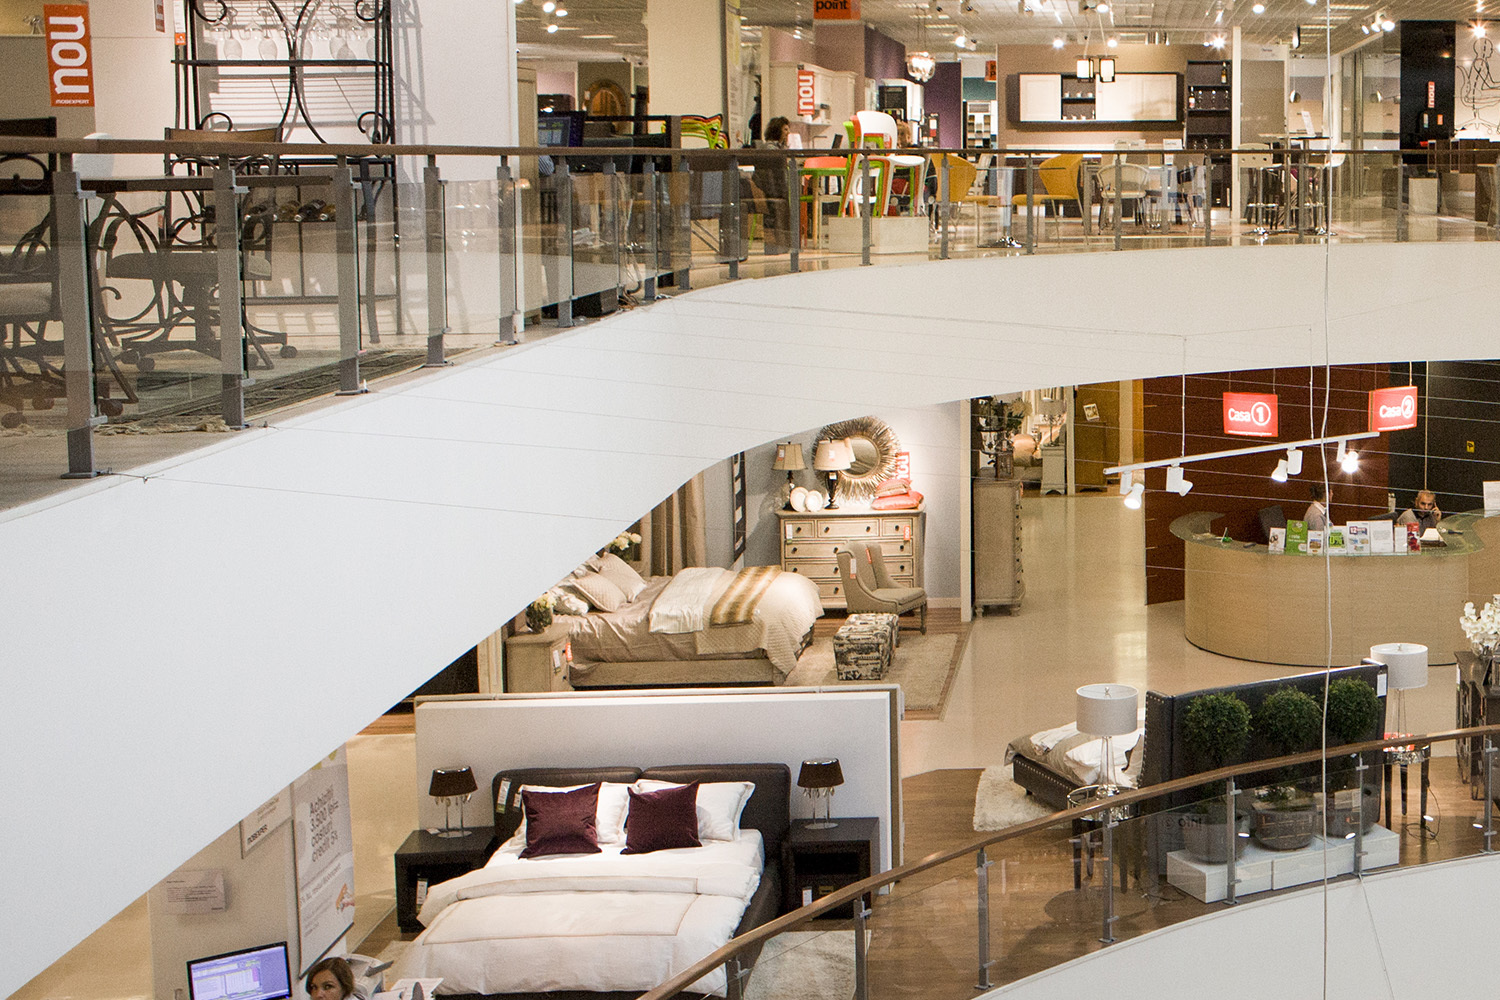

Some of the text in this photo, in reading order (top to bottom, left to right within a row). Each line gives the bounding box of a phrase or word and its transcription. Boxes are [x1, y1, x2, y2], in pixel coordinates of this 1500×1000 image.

[48, 15, 90, 95] nou
[799, 75, 814, 110] nou
[1228, 408, 1250, 422] Casa
[1380, 405, 1401, 418] Casa
